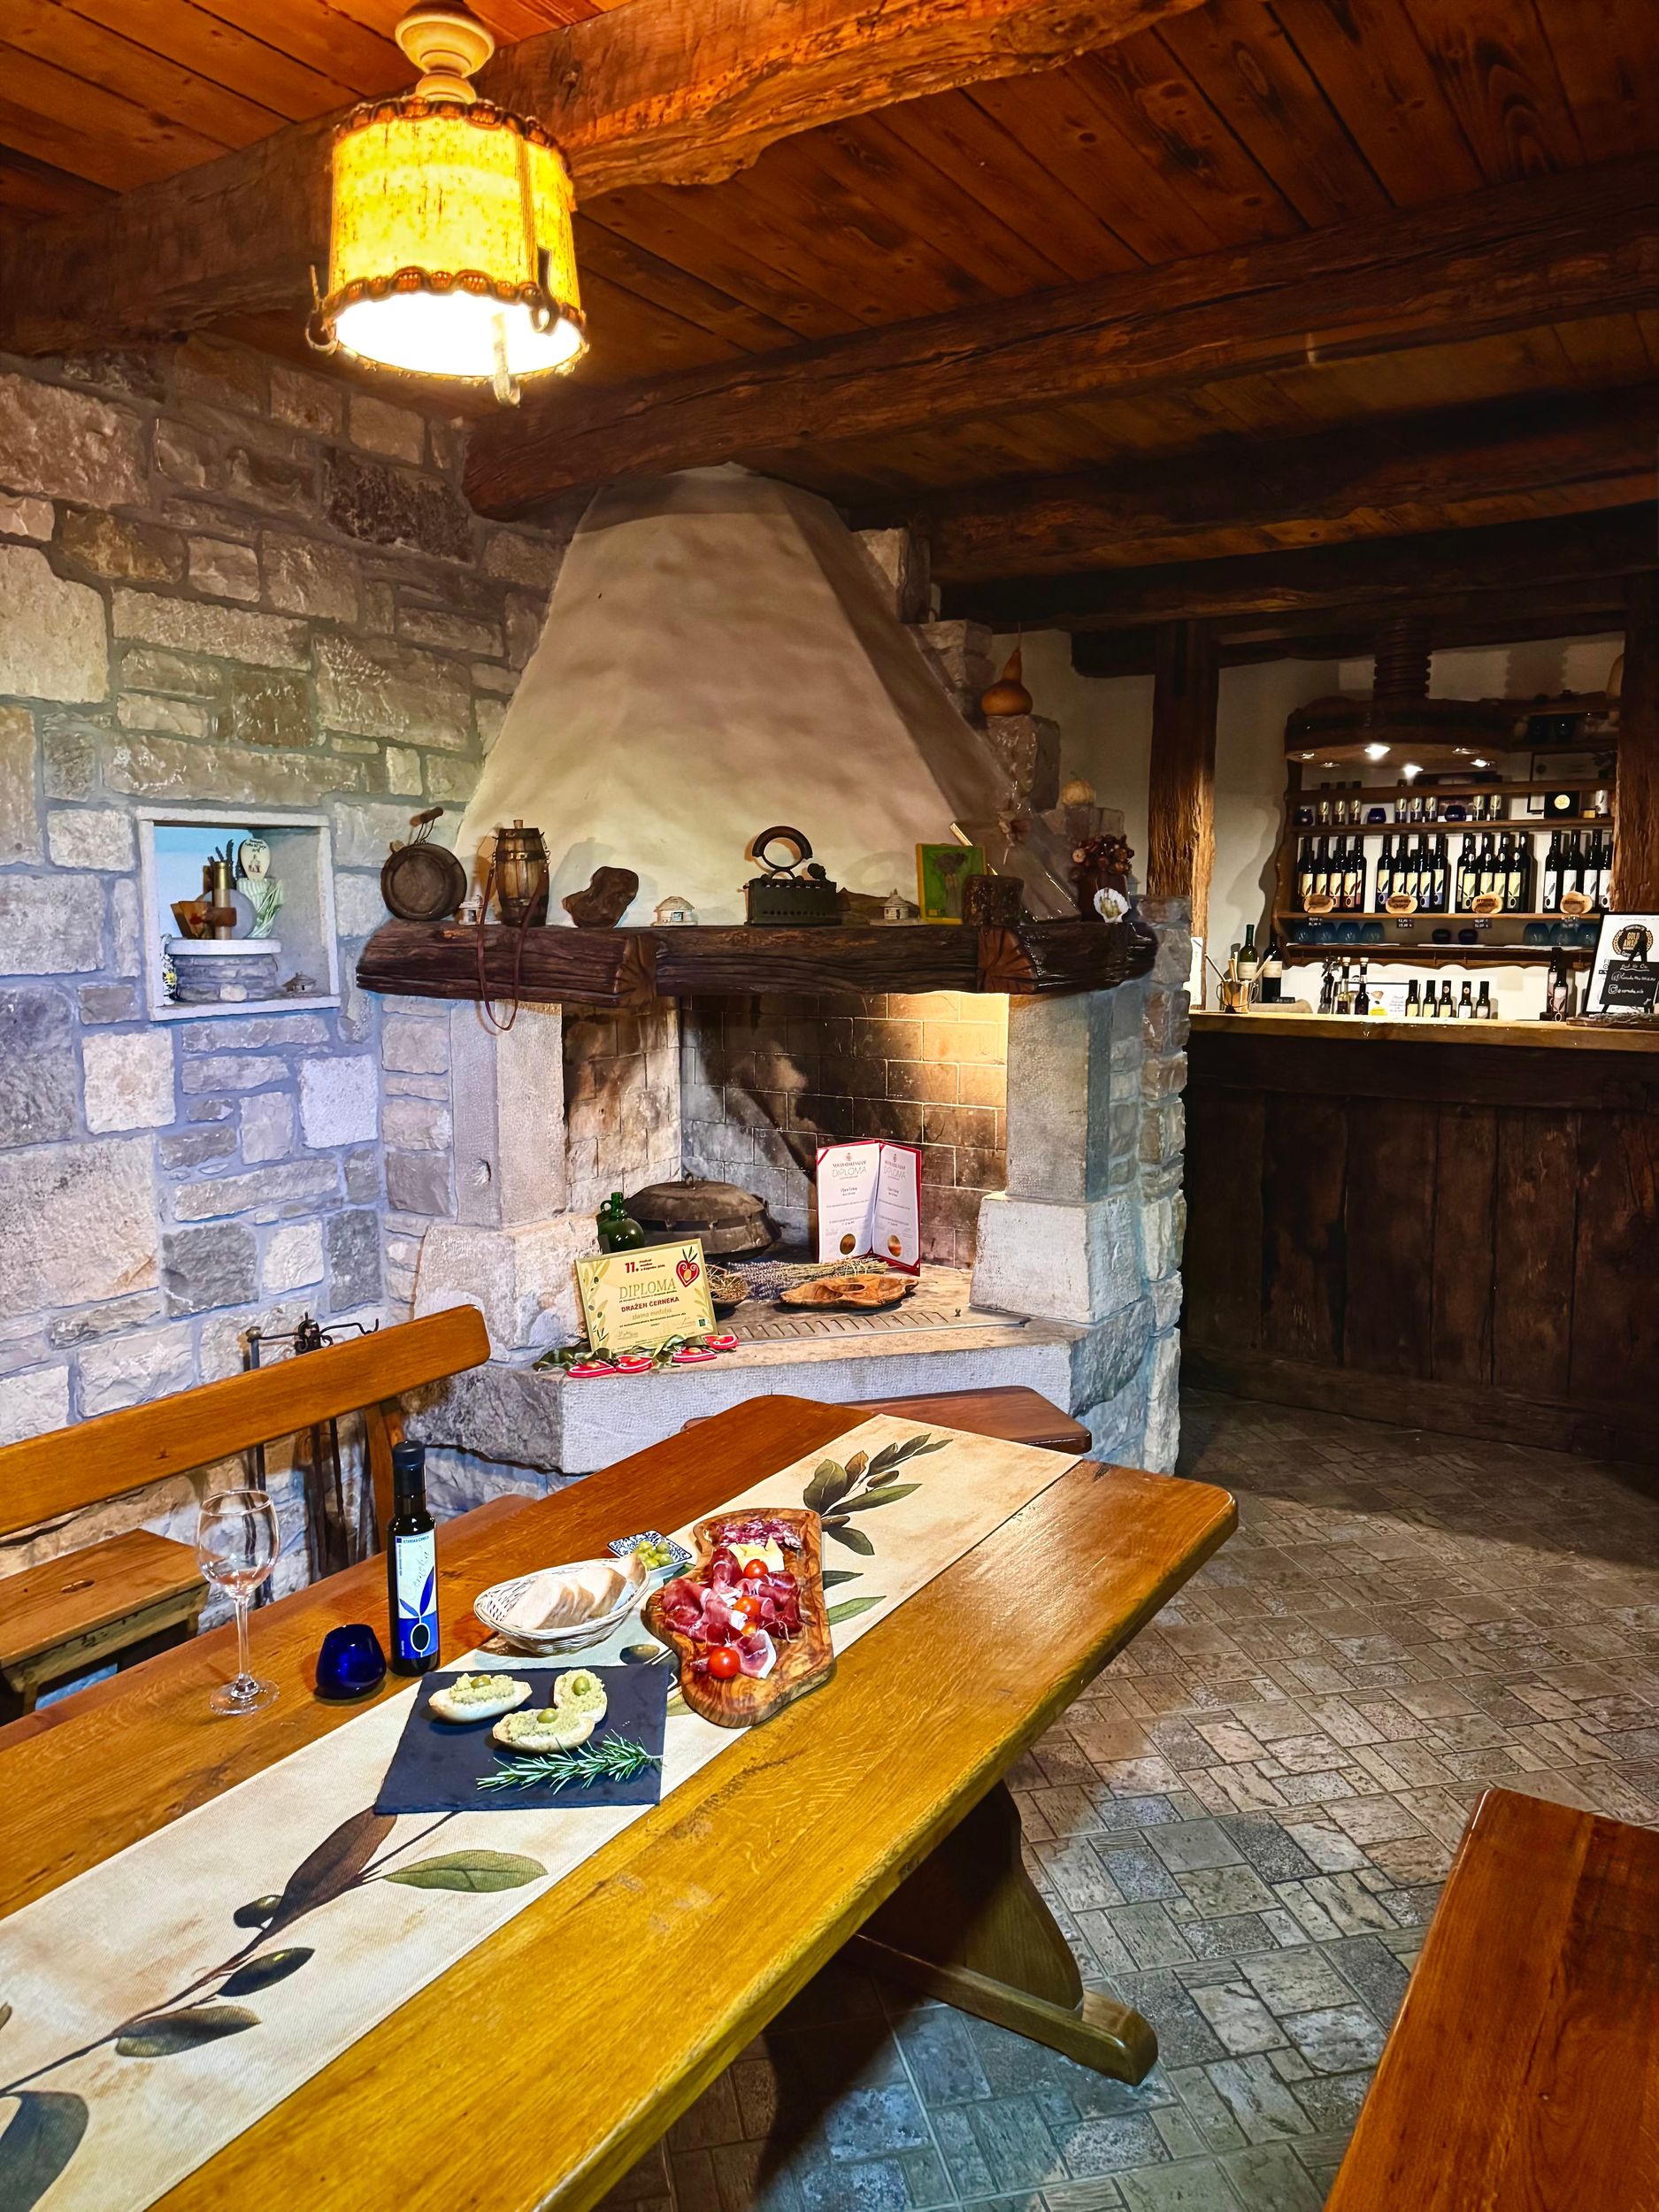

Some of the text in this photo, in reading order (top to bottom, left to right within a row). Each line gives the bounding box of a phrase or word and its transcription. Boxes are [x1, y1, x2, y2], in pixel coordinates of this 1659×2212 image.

[832, 1166, 867, 1179] DIPLOMA
[884, 1165, 905, 1179] DIPLOMA
[625, 1262, 639, 1273] 11.
[619, 1278, 676, 1299] DIPLOMA
[621, 1302, 648, 1312] DRAŽEN
